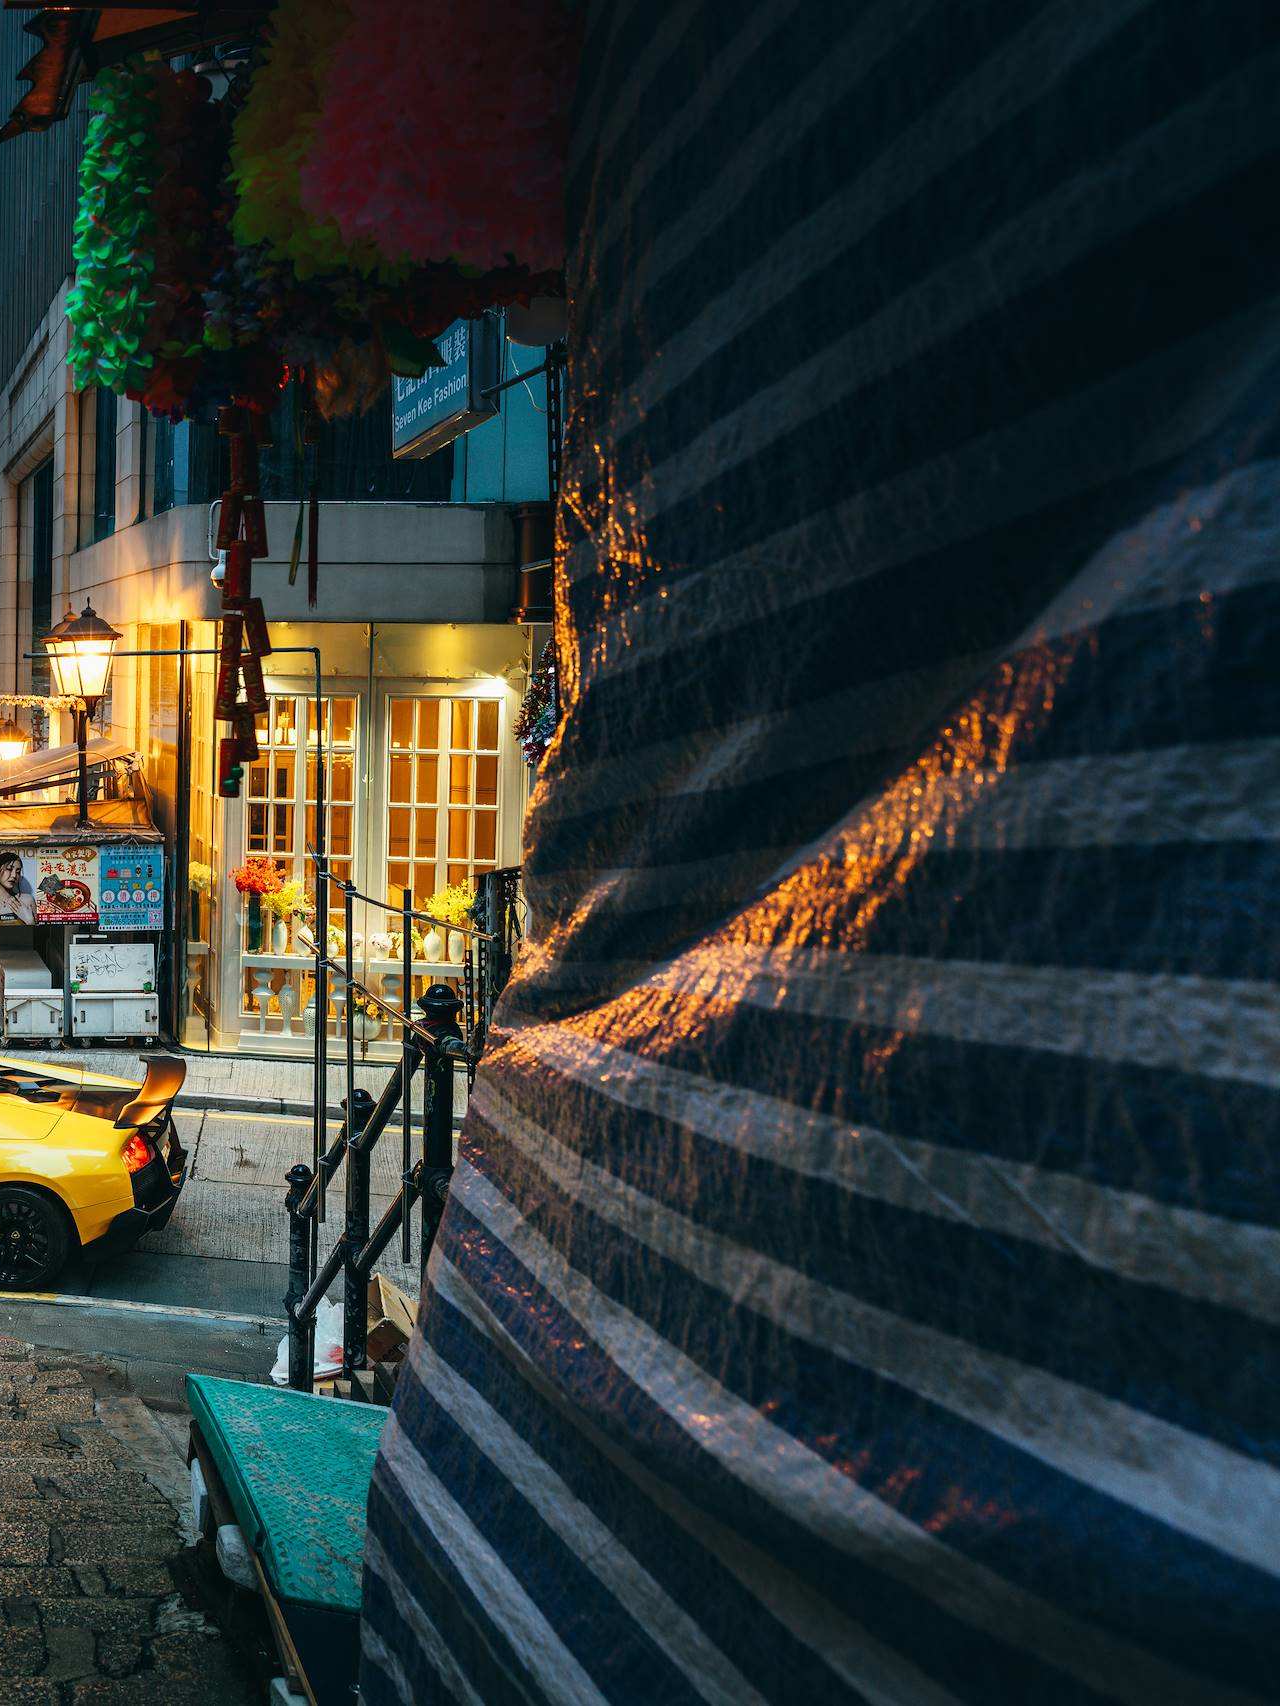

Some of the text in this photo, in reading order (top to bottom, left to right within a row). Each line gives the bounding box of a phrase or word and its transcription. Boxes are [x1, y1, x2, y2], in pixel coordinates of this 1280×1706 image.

[394, 373, 467, 433] Seven Kee Fashion
